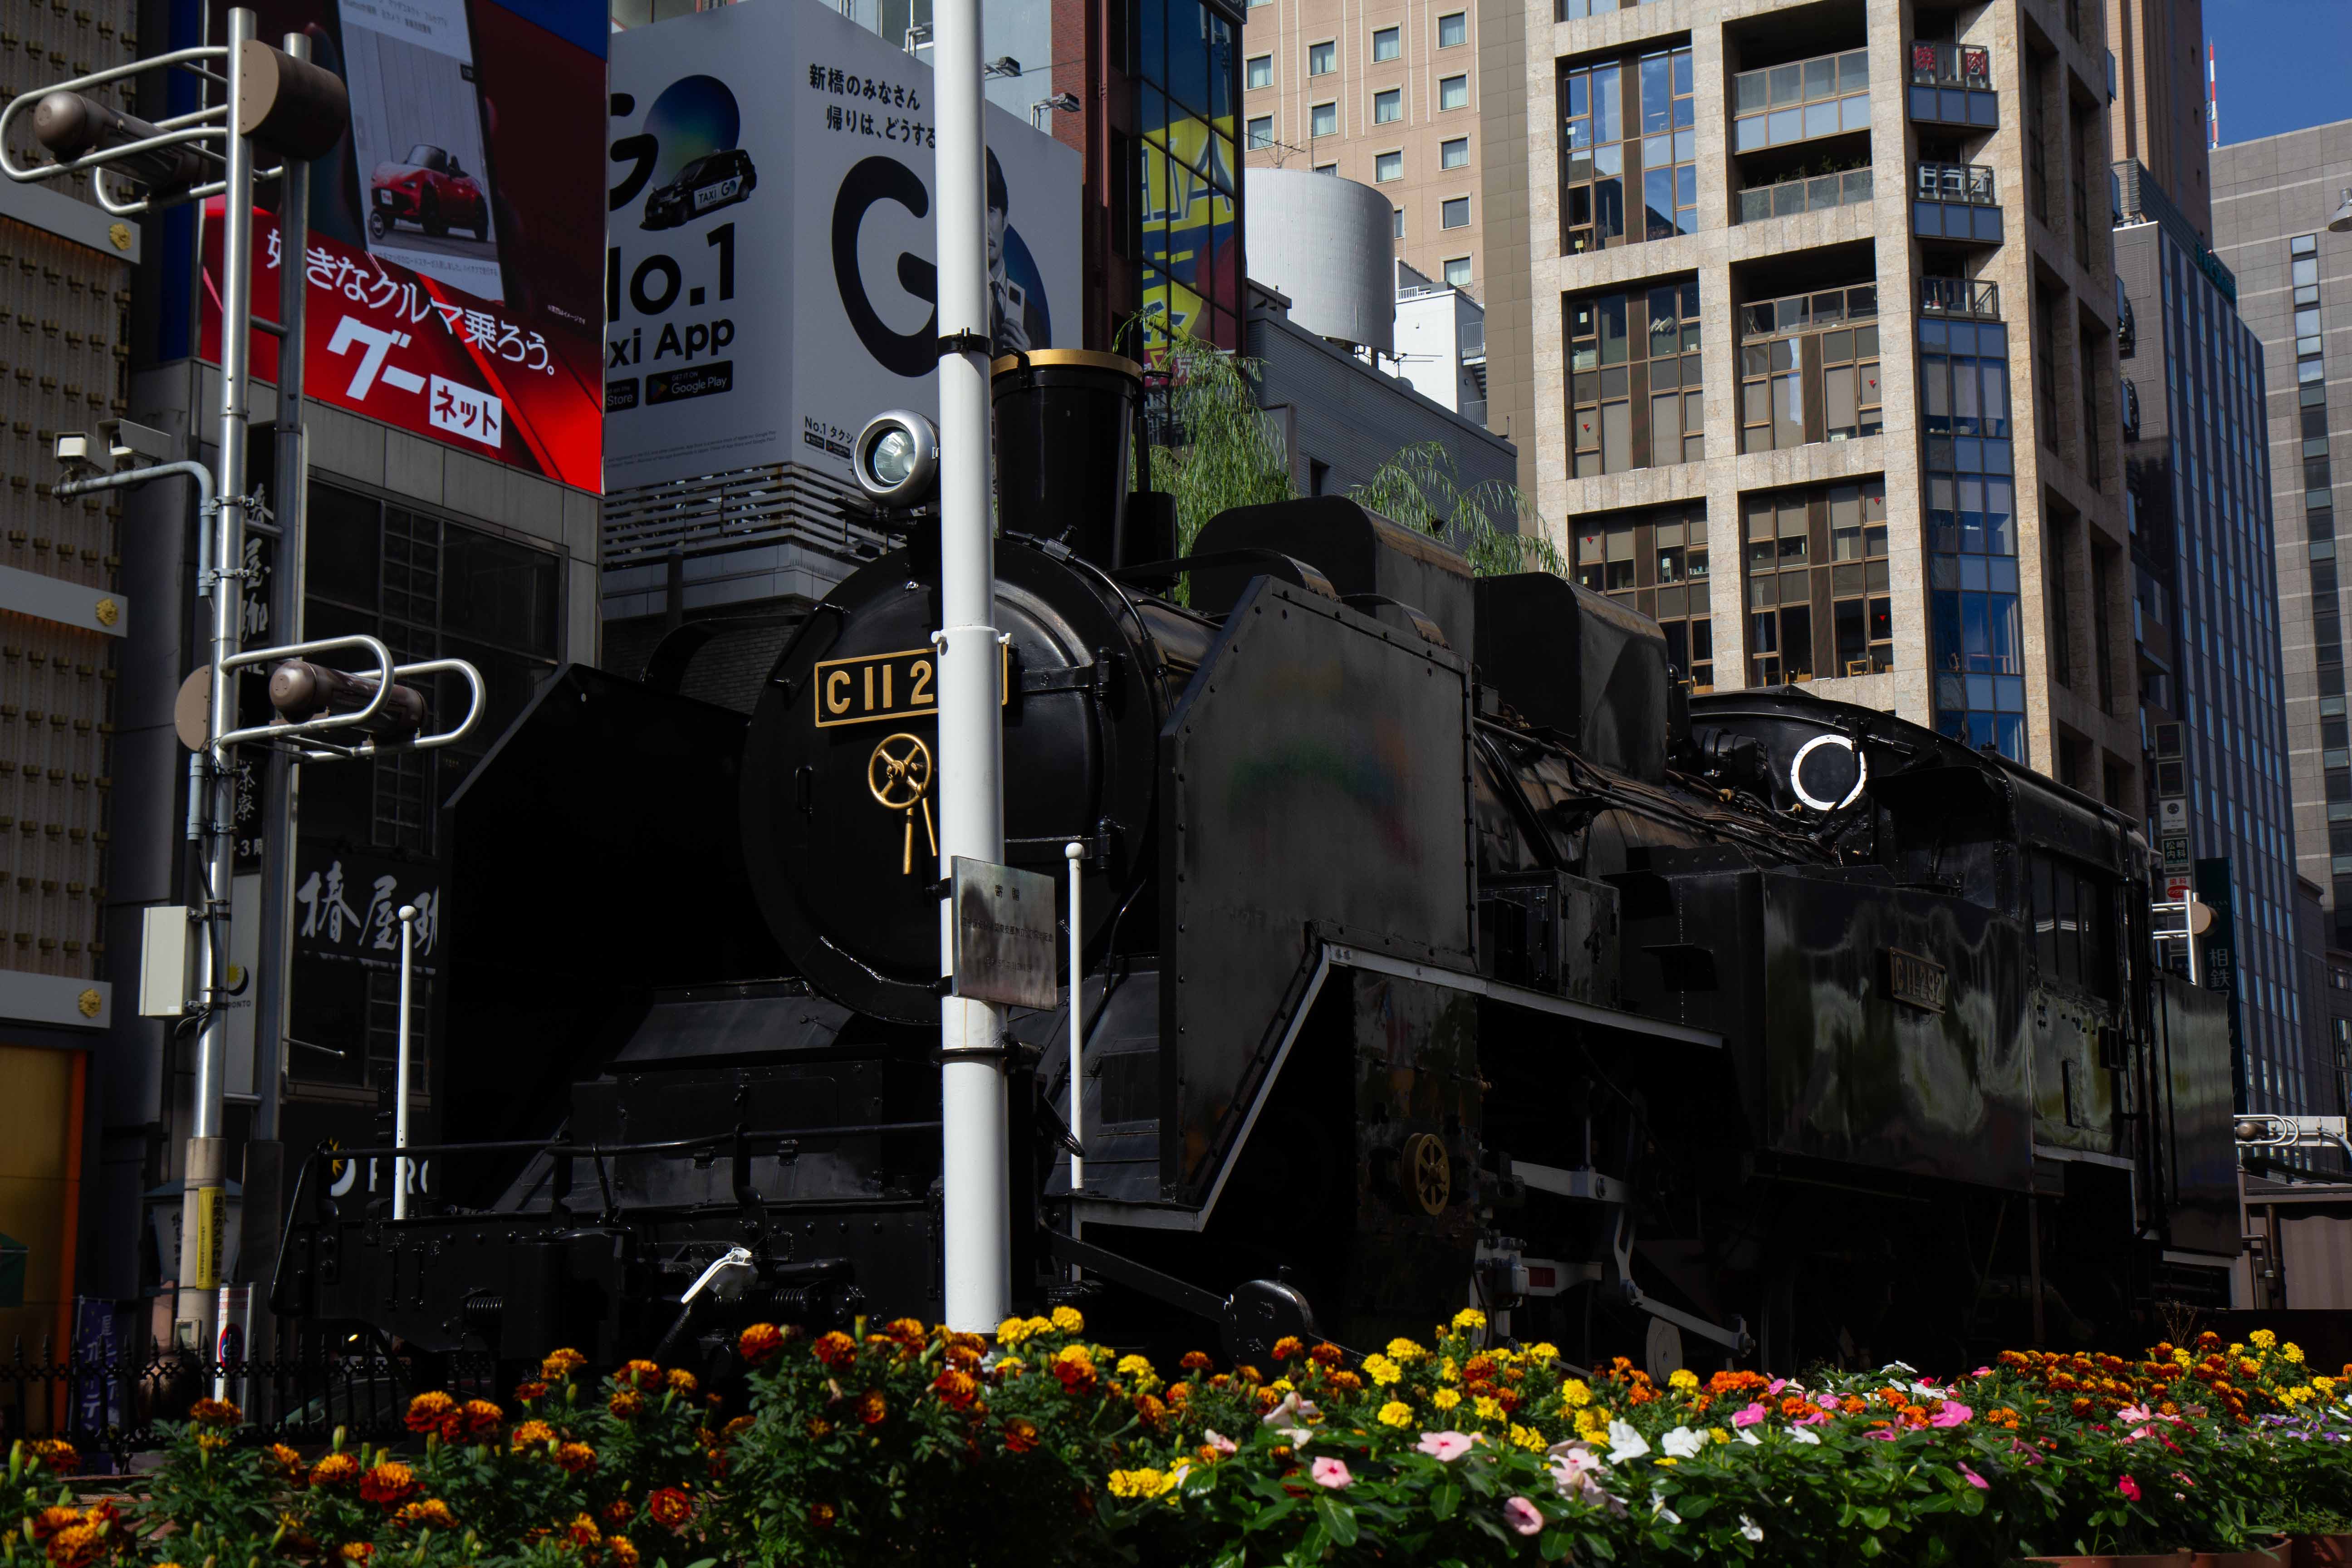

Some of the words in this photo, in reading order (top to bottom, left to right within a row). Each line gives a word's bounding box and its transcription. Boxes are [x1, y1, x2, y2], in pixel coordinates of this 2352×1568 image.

[810, 63, 921, 111] 新橋のみなさん
[827, 104, 936, 148] 帰りは、どうする
[698, 189, 717, 204] TAXI
[654, 318, 734, 361] App
[671, 378, 706, 394] Google
[708, 375, 728, 388] Play
[607, 394, 633, 407] Store
[805, 415, 826, 436] No.1
